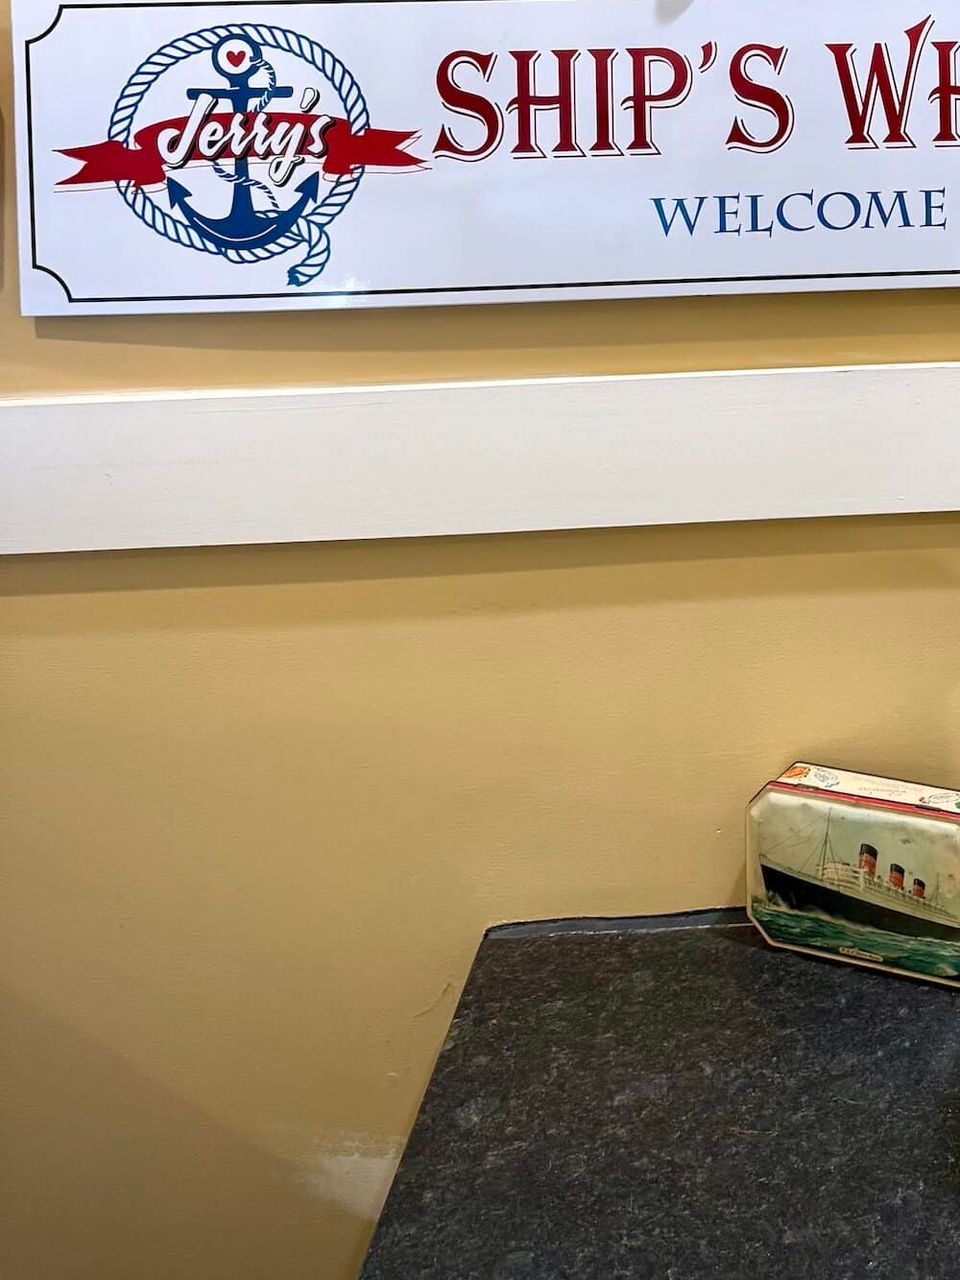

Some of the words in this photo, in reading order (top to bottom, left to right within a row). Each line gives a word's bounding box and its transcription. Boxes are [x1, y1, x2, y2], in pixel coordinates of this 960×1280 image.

[157, 87, 336, 187] Jerry's
[432, 41, 795, 162] SHIP'S
[649, 186, 948, 238] WELCOME
